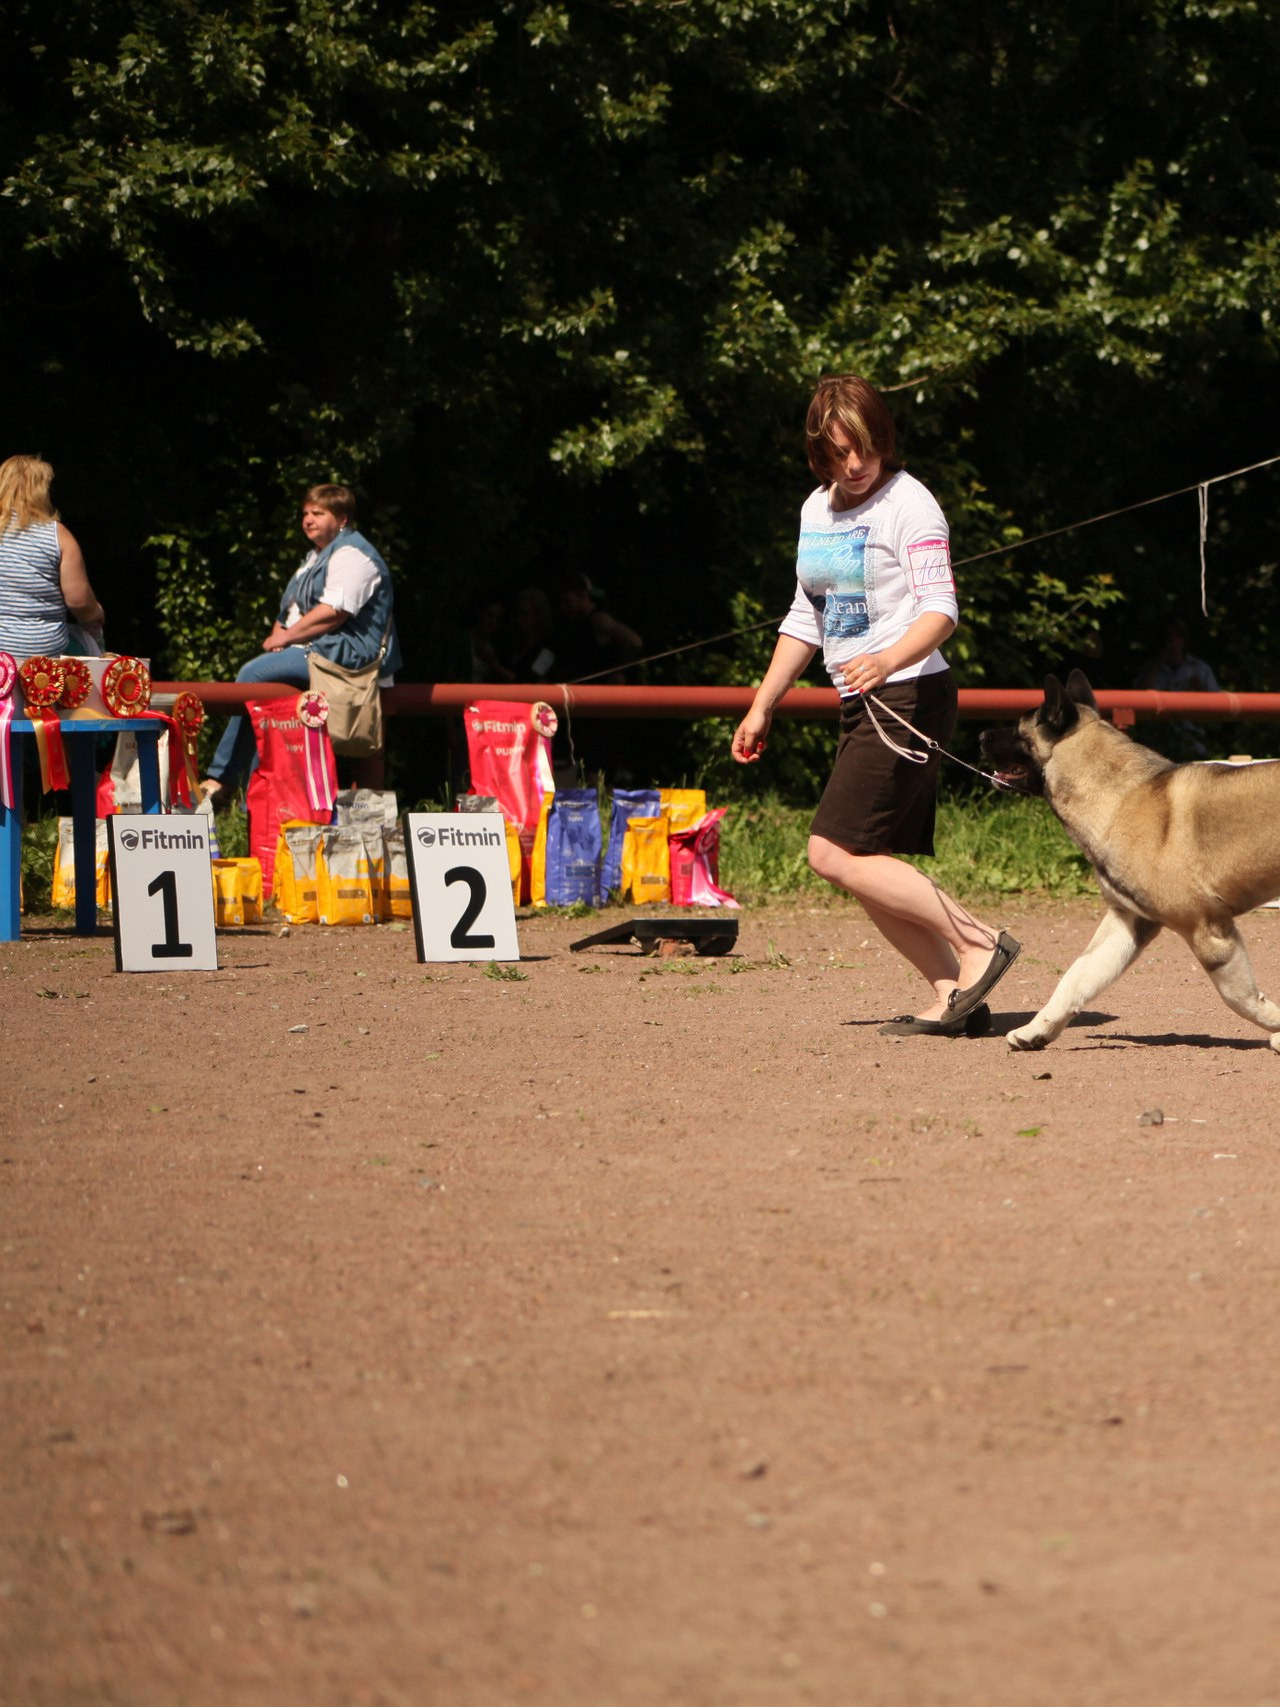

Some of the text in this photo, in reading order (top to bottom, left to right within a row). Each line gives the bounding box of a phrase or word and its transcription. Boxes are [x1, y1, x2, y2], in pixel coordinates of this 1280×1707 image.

[483, 720, 526, 733] Fitmin
[142, 829, 204, 849] Fitmin
[438, 827, 501, 846] Fitmin
[148, 870, 193, 958] 1
[444, 866, 495, 949] 2
